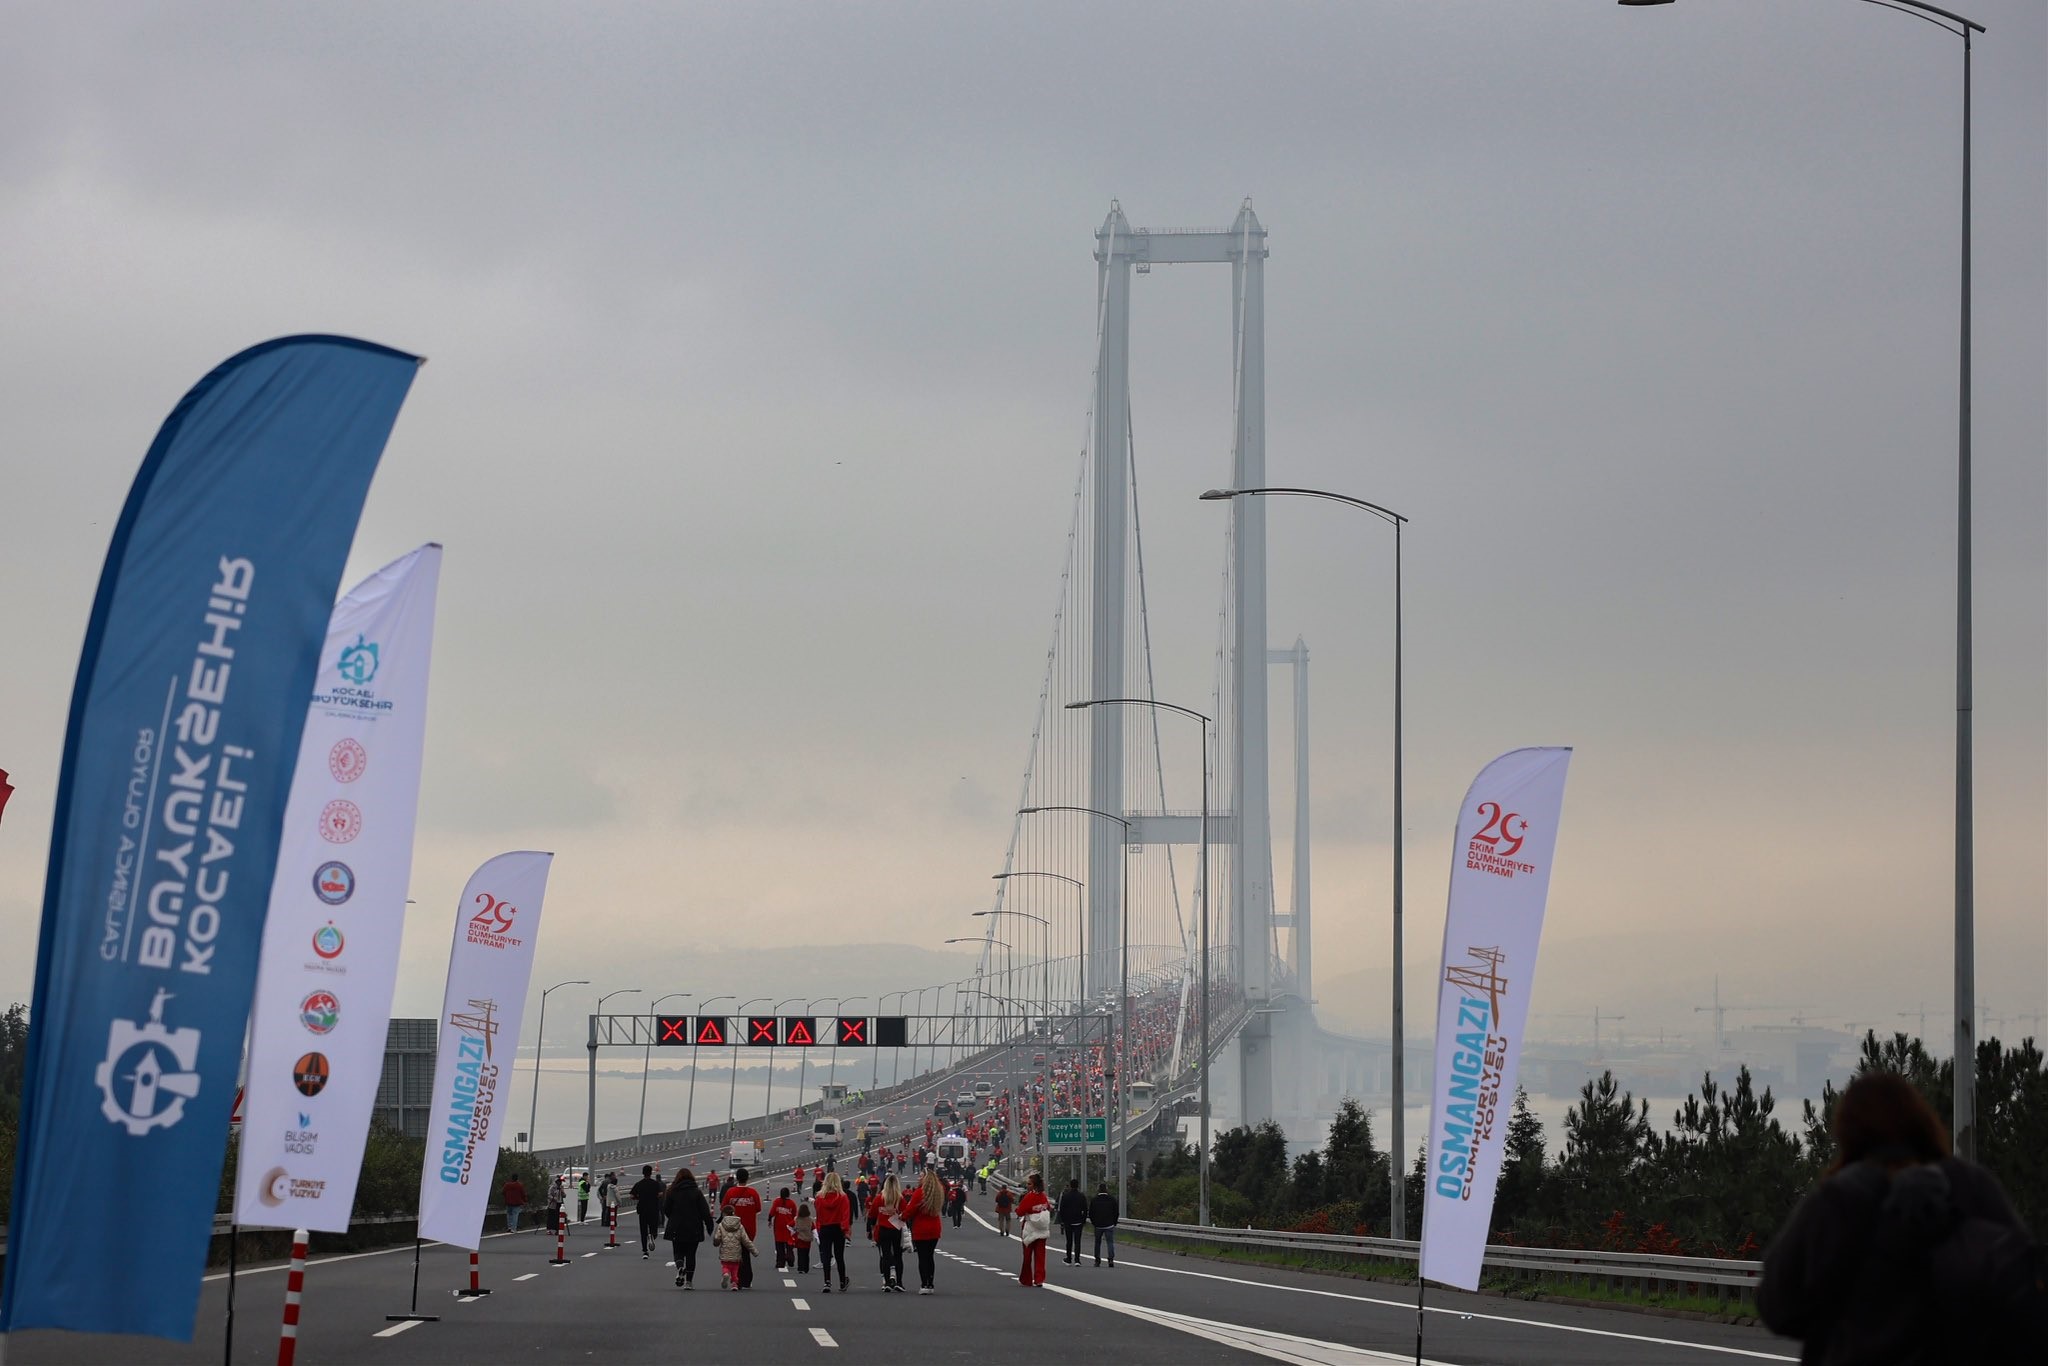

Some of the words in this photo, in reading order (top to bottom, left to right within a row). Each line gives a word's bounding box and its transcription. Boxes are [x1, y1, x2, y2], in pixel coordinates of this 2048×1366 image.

[1471, 802, 1524, 856] 29
[1468, 851, 1535, 874] CUMHURİYET
[1469, 841, 1494, 854] EKİM
[1466, 860, 1513, 878] BAYRAMI
[469, 922, 490, 932] EKİM
[471, 893, 513, 933] 29
[467, 936, 505, 949] BAYRAMI
[468, 929, 522, 947] CUMHURİYET
[478, 1065, 499, 1141] KOŞUSU
[1482, 1037, 1508, 1140] KOŞUSU
[461, 1063, 490, 1185] CUMHURİYET
[1462, 1034, 1498, 1201] CUMHURİYET
